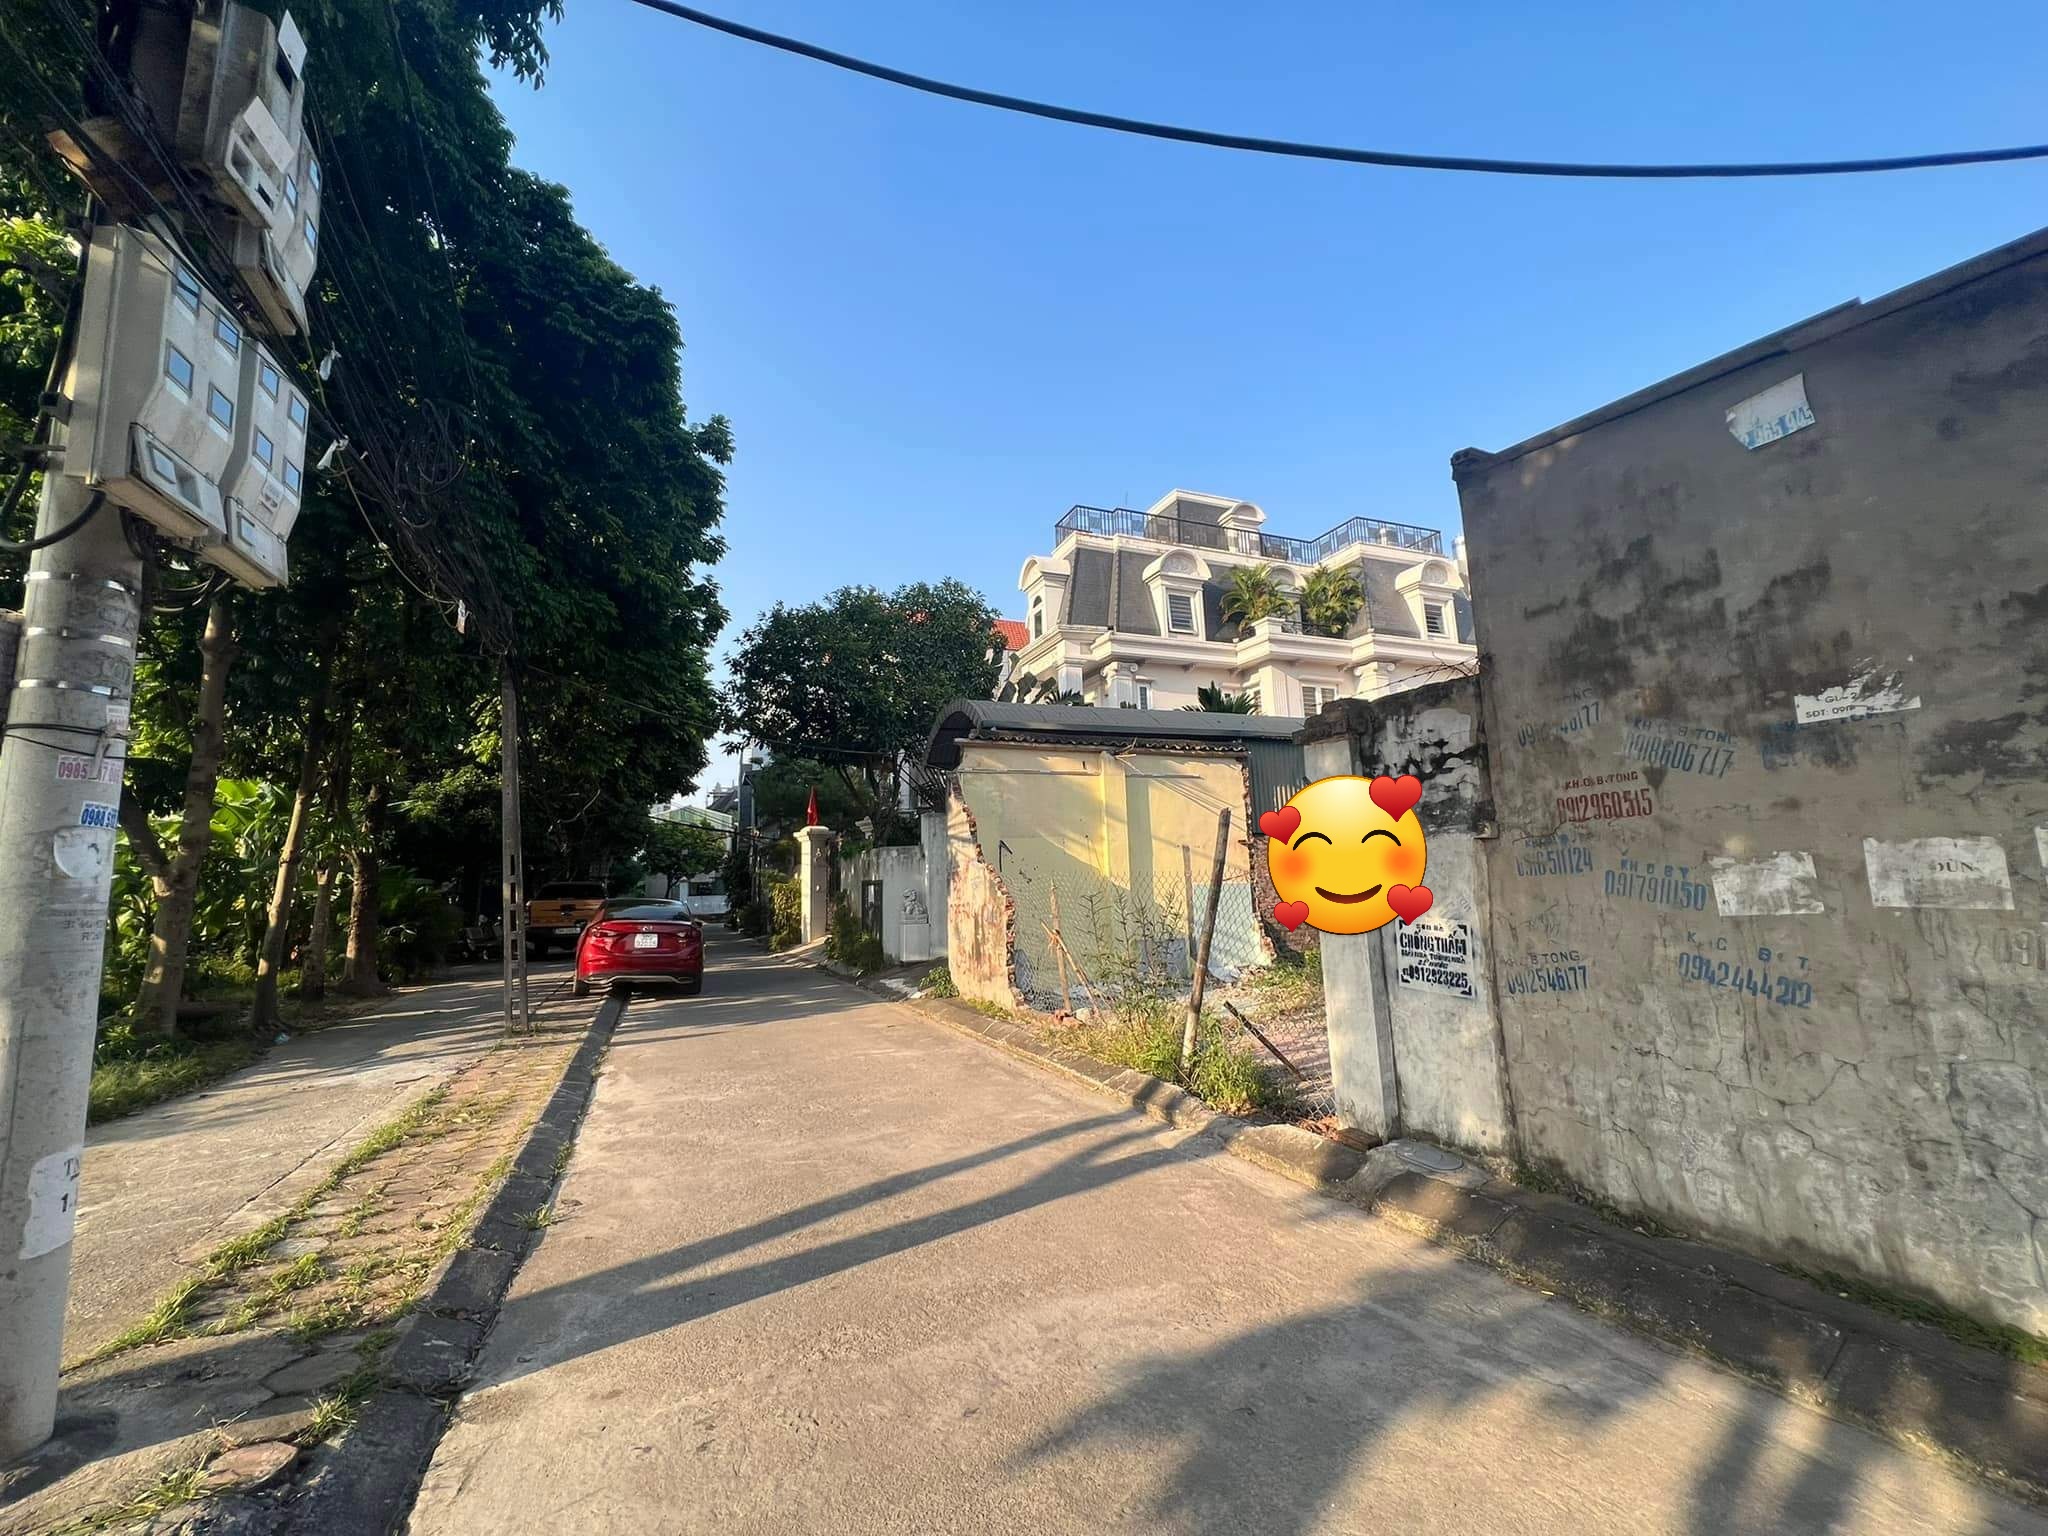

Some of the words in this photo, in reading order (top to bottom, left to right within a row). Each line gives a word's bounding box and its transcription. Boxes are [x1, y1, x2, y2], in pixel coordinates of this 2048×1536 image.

[1556, 788, 1654, 825] 0912960515
[1515, 846, 1594, 878] 016511124
[1604, 868, 1708, 912] 0917911150
[1400, 928, 1434, 952] CHỐNG
[1434, 930, 1467, 956] THẤM
[1507, 964, 1589, 996] 0912546177
[1679, 952, 1813, 1009] 0942444212
